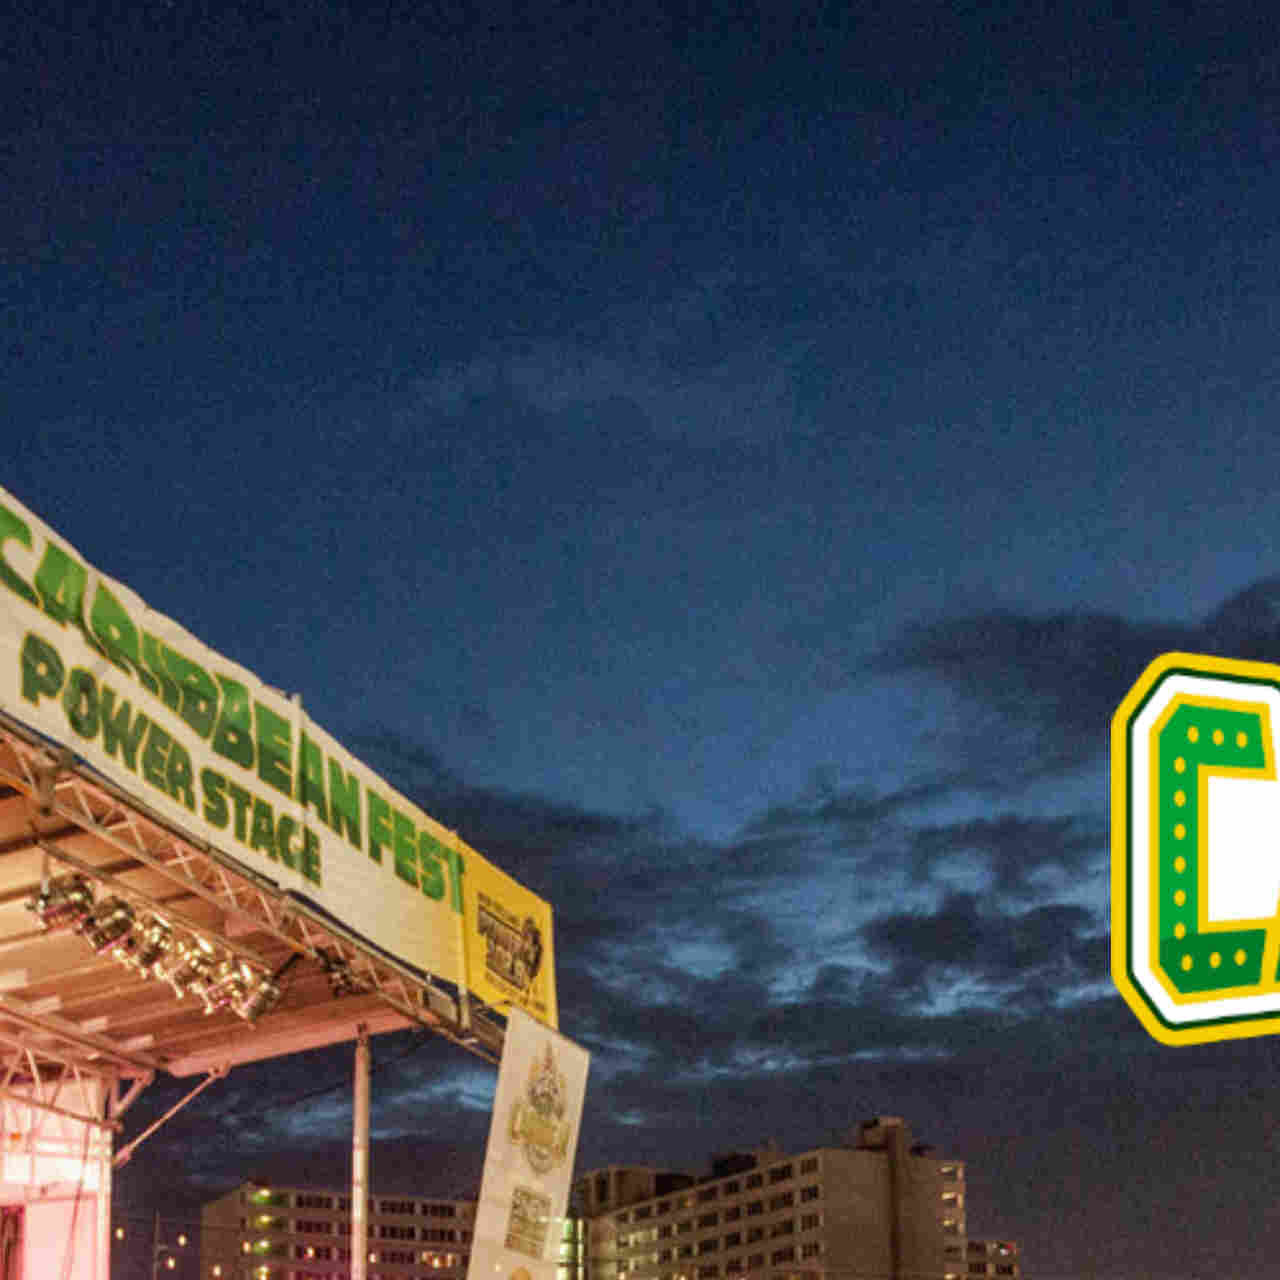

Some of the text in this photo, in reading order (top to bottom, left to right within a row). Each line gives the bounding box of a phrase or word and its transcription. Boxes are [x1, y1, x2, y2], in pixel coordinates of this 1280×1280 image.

[19, 631, 322, 888] POWER STAGE
[366, 786, 465, 916] FEST
